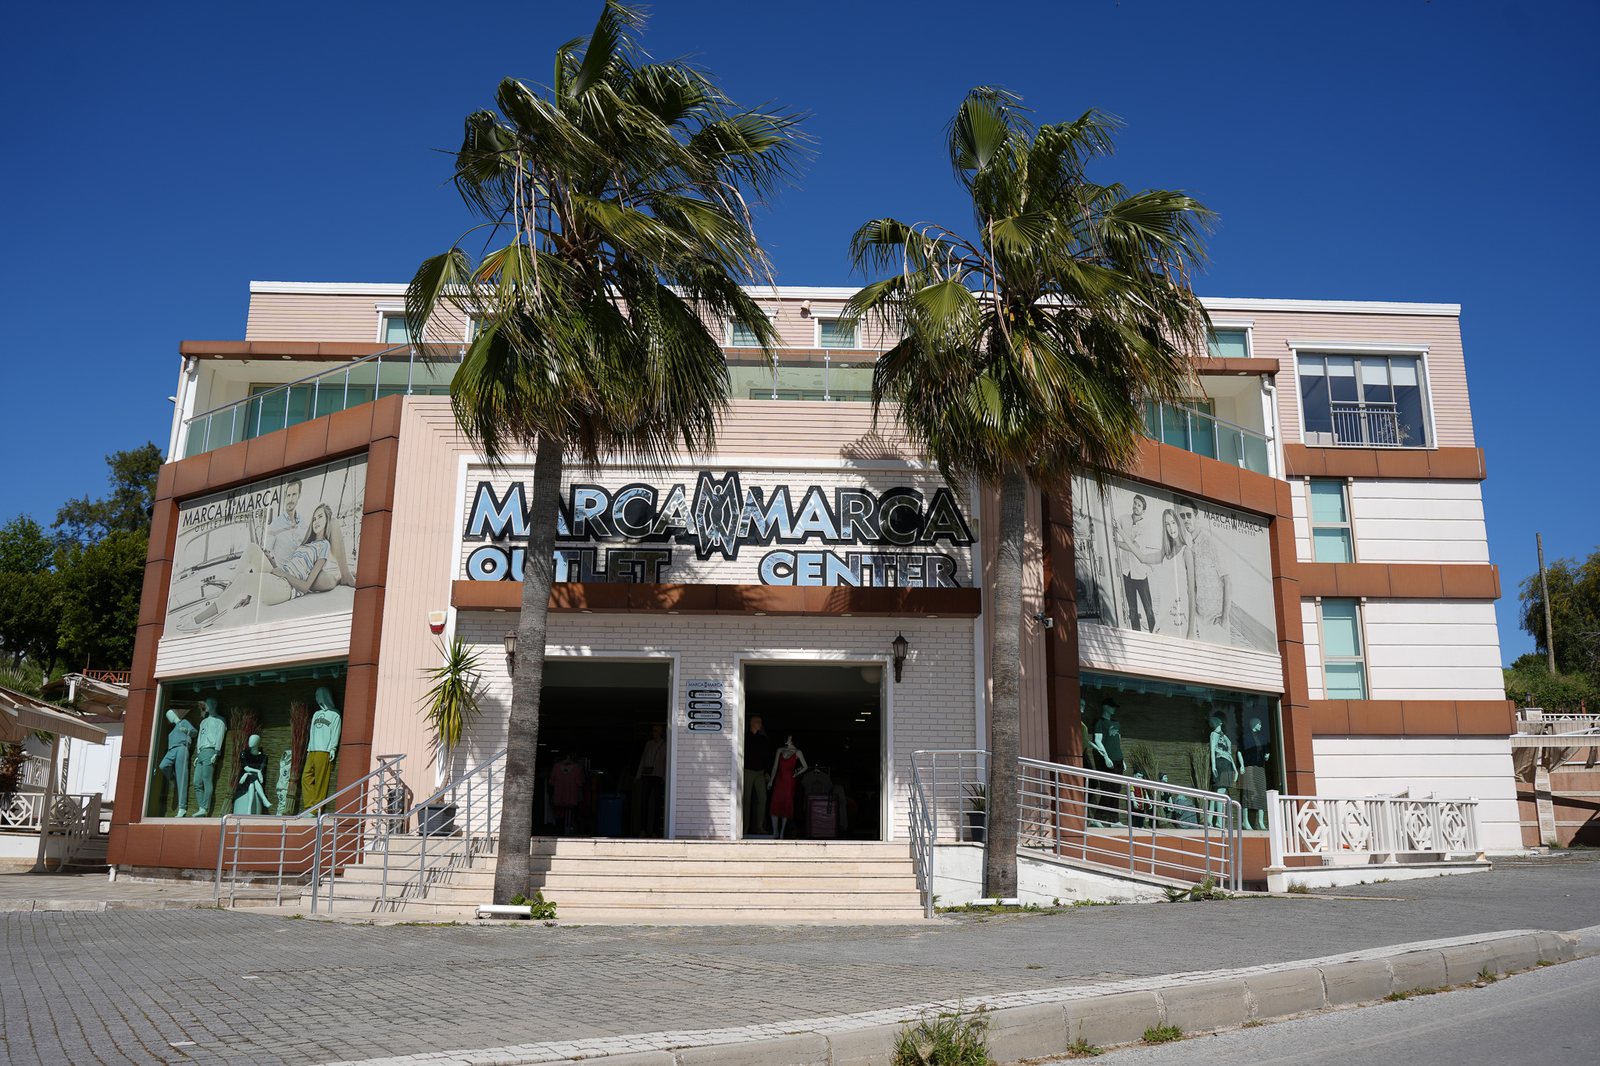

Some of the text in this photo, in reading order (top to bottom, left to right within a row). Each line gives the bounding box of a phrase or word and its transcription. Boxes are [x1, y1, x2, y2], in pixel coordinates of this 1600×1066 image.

[182, 488, 279, 527] MARCA MARCA
[194, 519, 222, 532] OUTLET
[738, 485, 977, 546] MARCA
[1203, 511, 1264, 533] MARCA MARCA
[758, 550, 962, 588] CENTER
